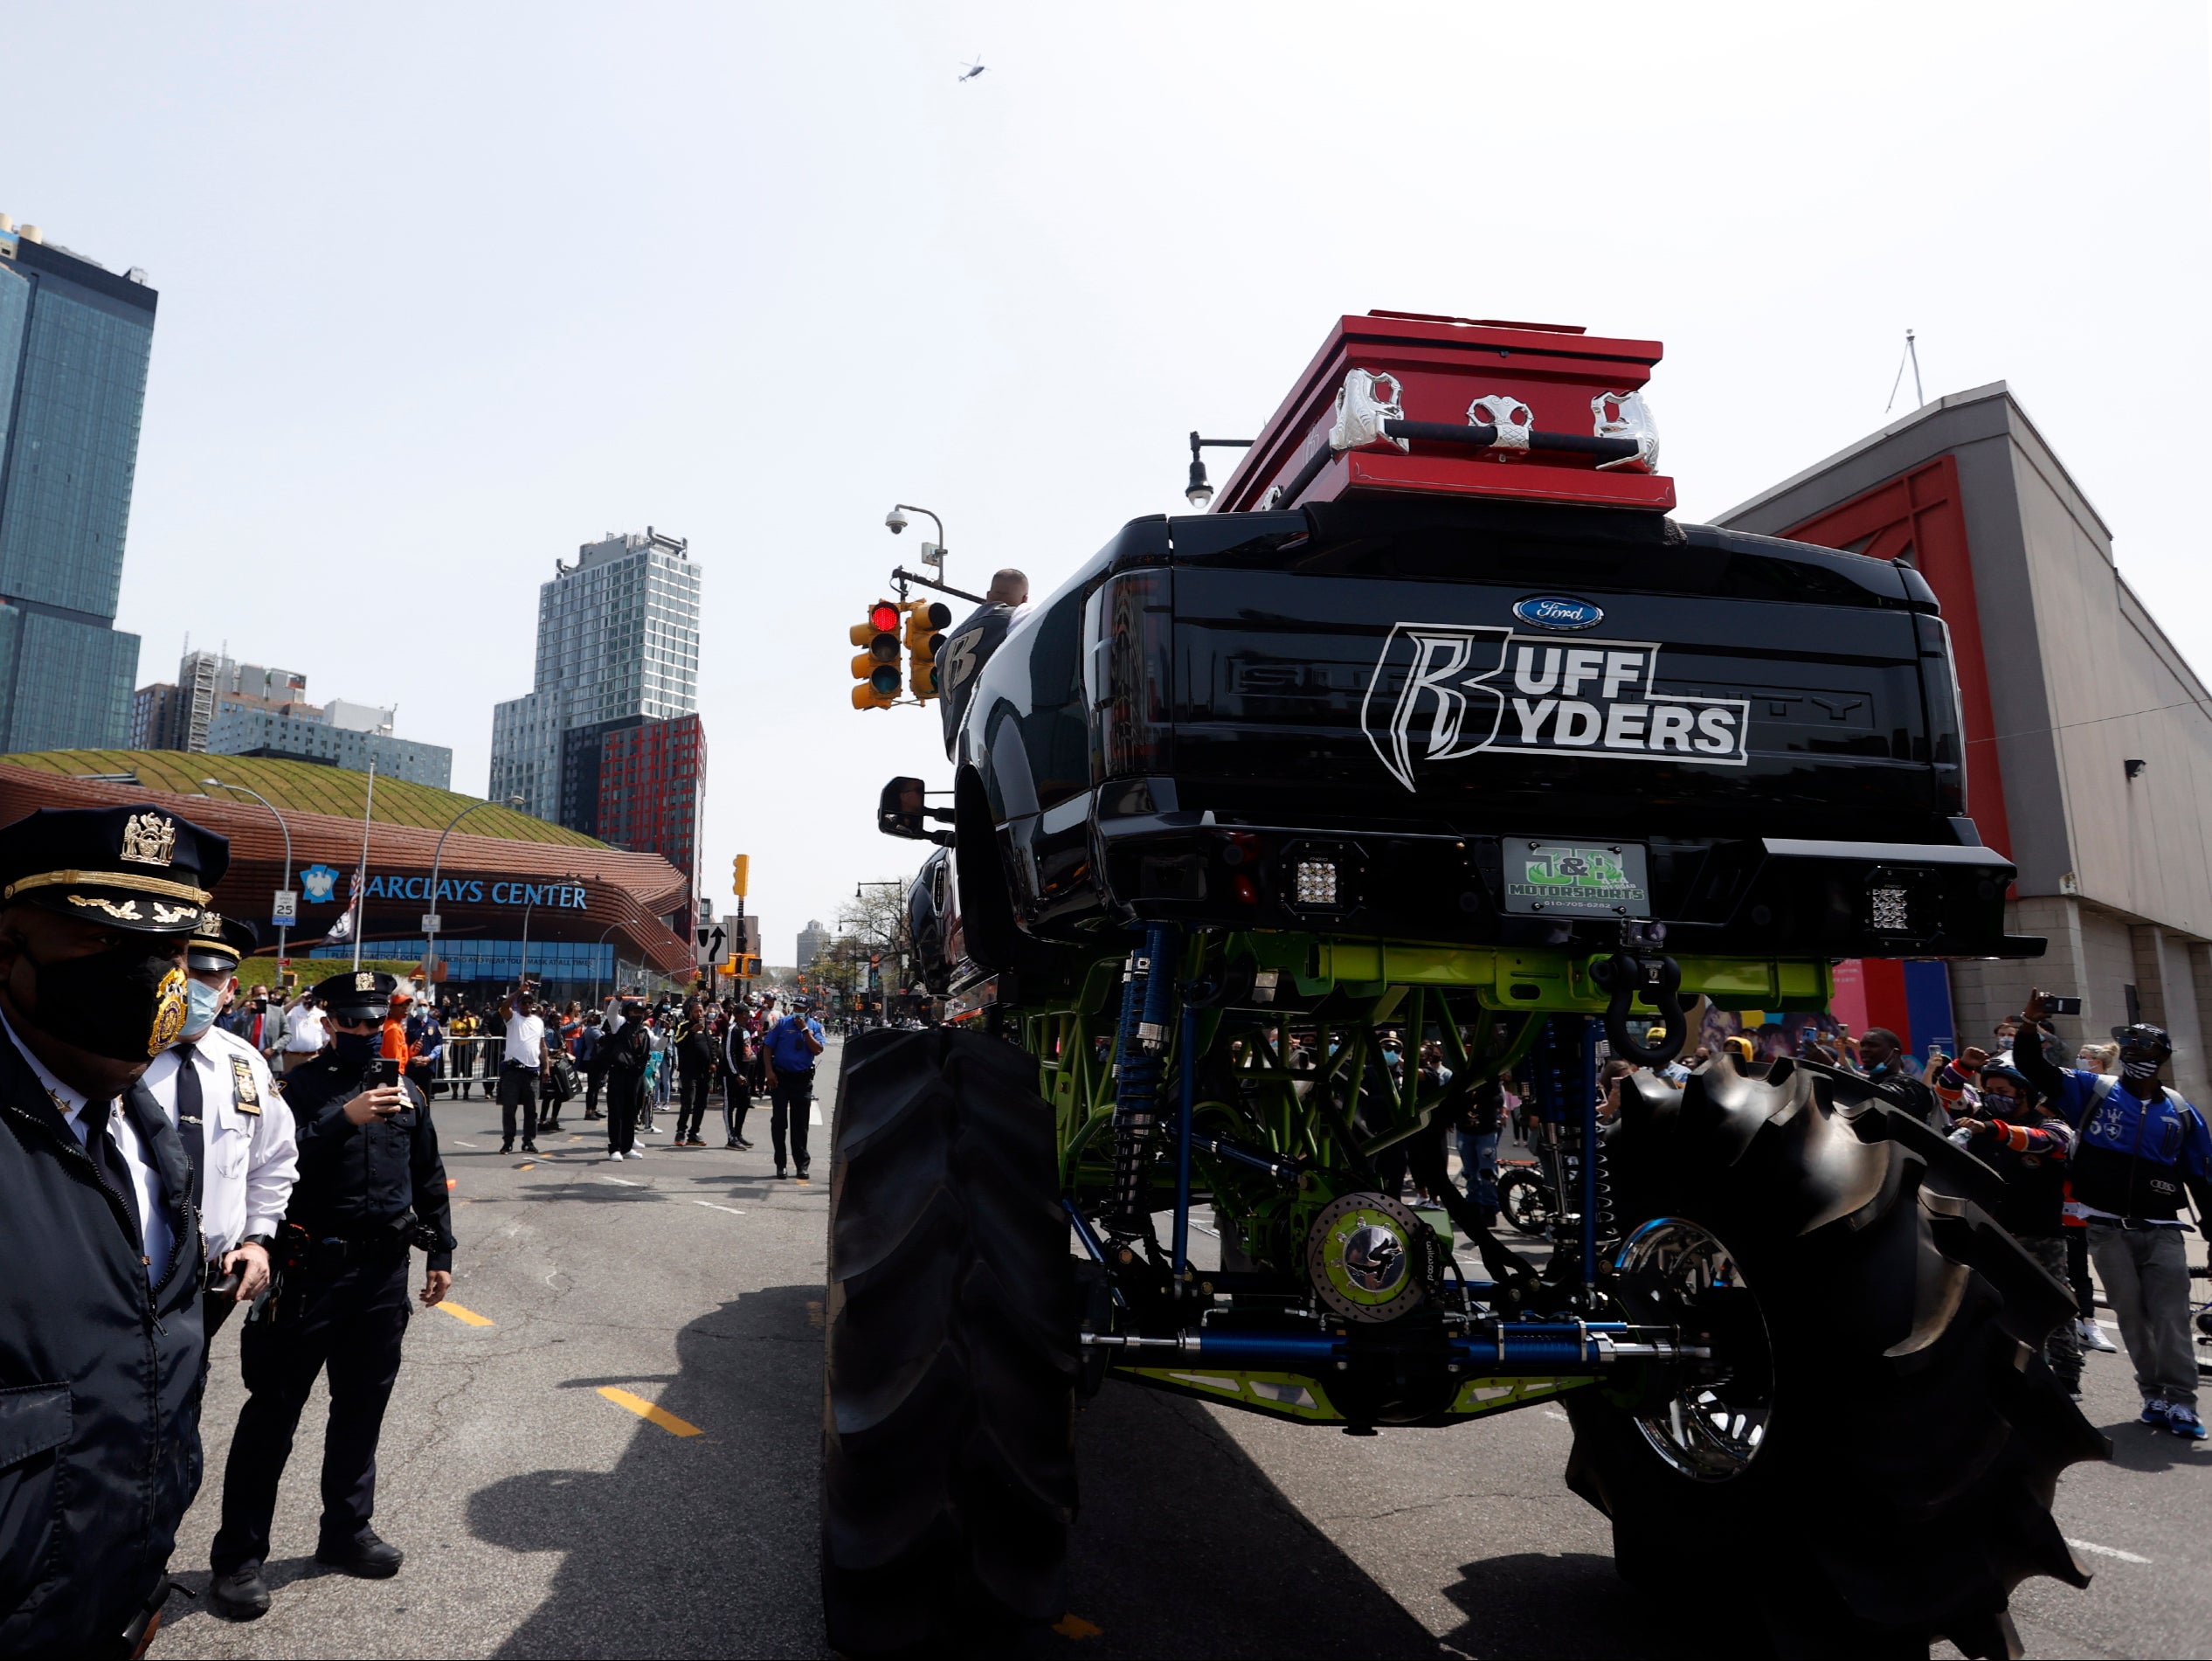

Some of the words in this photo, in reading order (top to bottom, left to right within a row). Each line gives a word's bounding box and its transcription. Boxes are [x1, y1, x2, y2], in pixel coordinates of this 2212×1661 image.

[1537, 600, 1583, 620] Ford
[349, 875, 484, 903] ARCLAYS
[492, 882, 588, 910] CENTER
[1508, 883, 1645, 901] MOTORSPORTS
[276, 905, 293, 915] 25
[1426, 1240, 1435, 1282] wilwood
